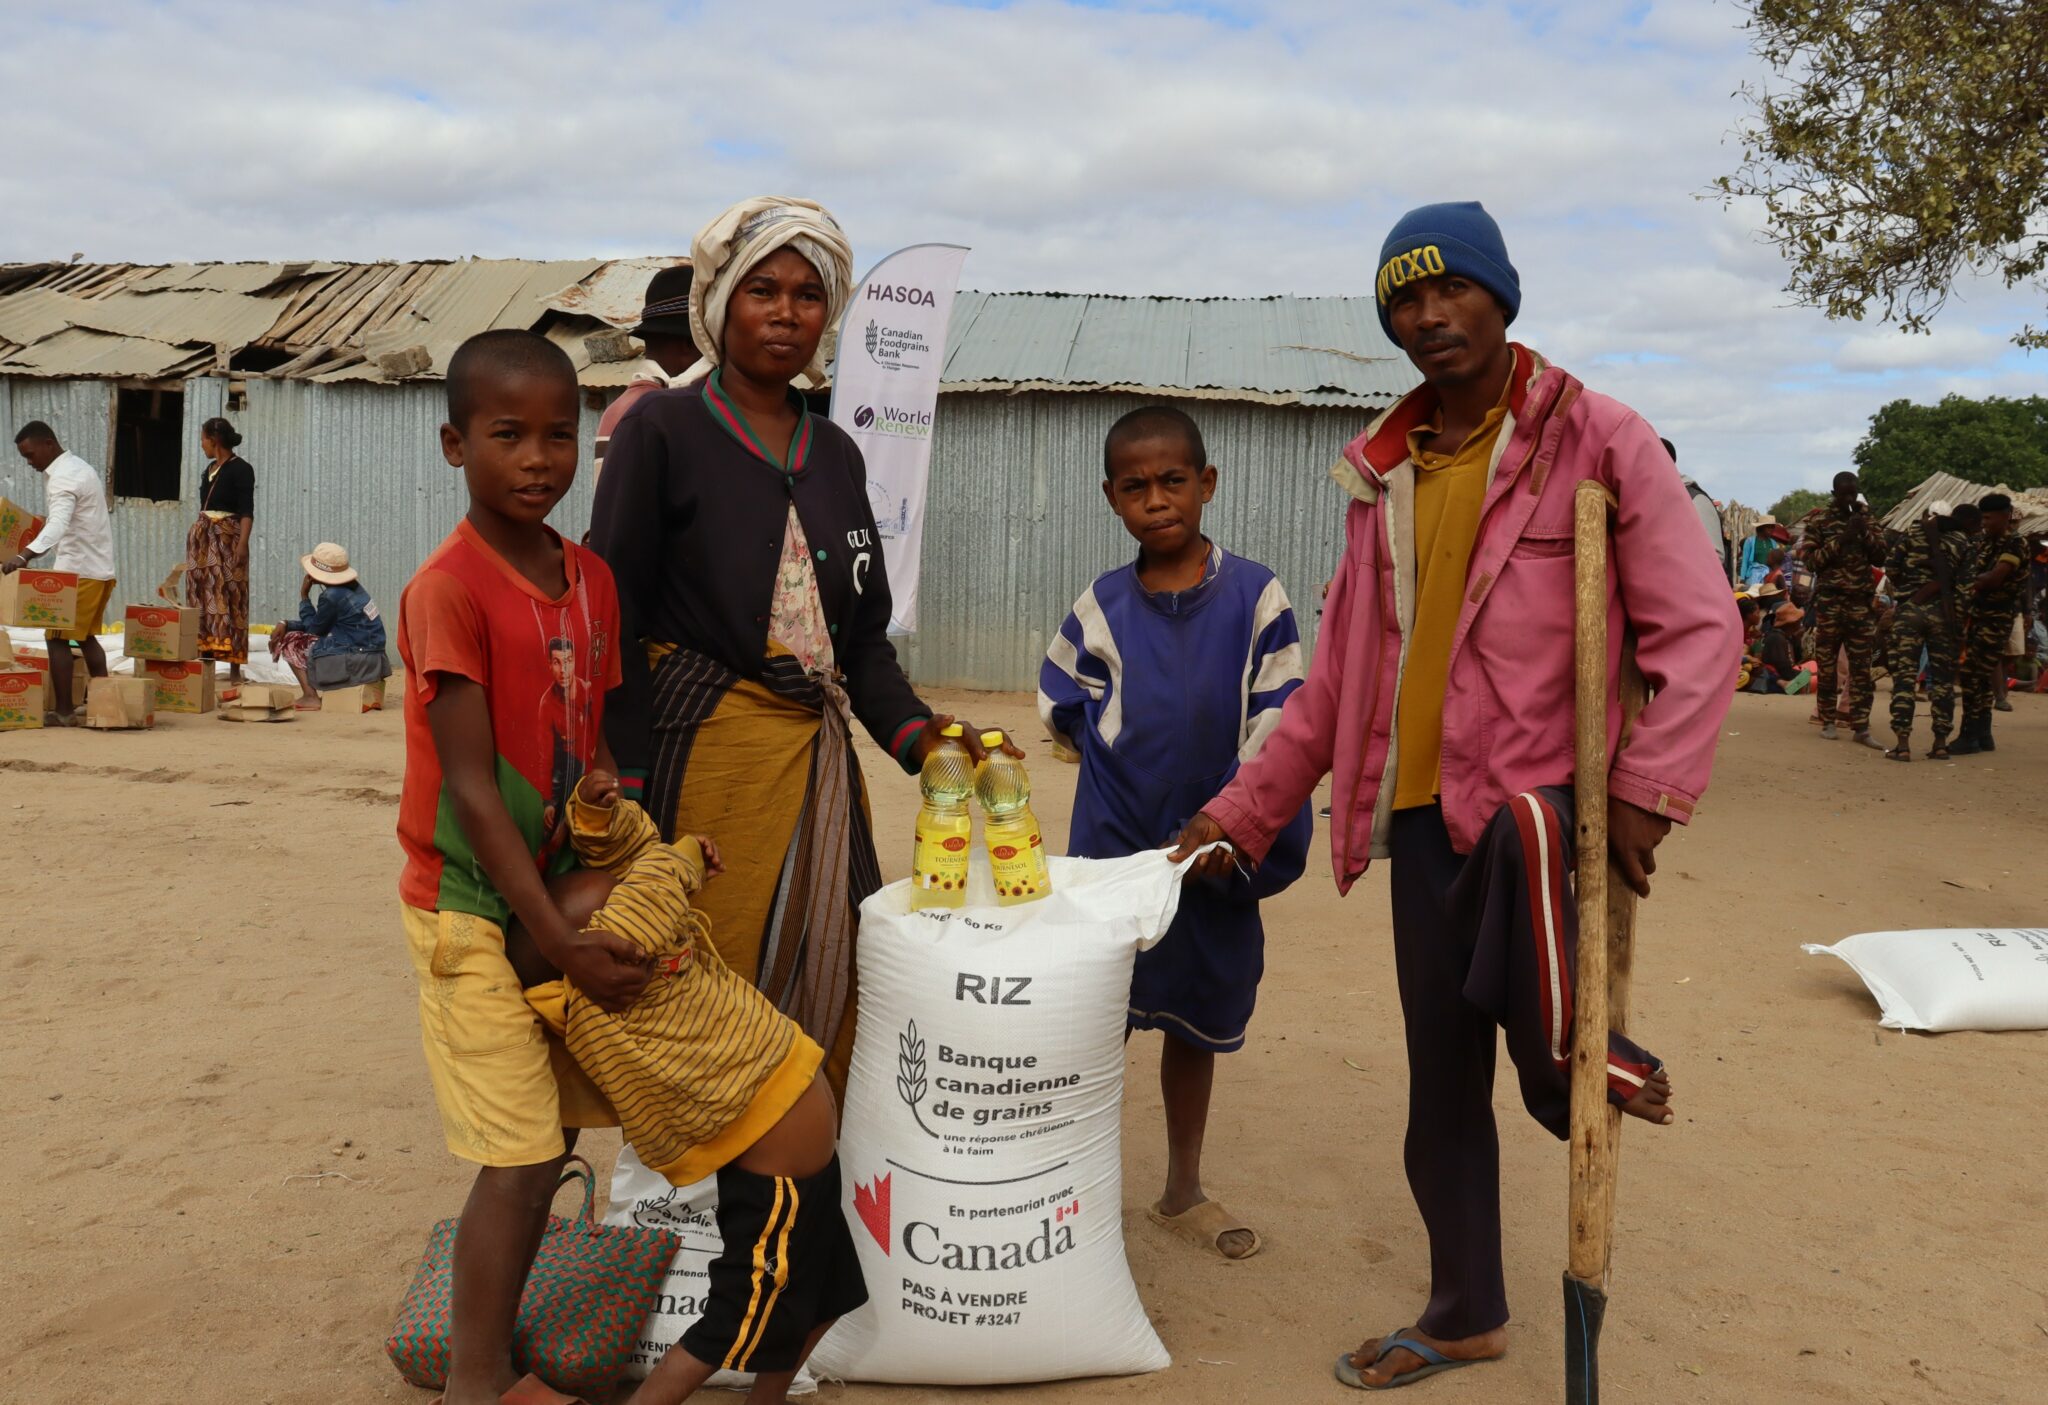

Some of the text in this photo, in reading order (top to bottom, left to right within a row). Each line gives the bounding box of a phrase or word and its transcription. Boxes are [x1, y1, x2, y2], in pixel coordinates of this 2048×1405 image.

[867, 284, 935, 308] HASOA
[879, 339, 929, 353] Foodgrains
[881, 327, 923, 341] Canadian
[878, 348, 901, 359] Bank
[875, 416, 930, 436] Renew
[884, 406, 931, 426] World
[929, 913, 952, 922] NET
[964, 917, 980, 929] 60
[955, 972, 1033, 1006] RIZ
[938, 1044, 1038, 1074] Banque
[935, 1073, 1081, 1096] canadienne
[932, 1100, 1053, 1126] de grains
[943, 1118, 1075, 1145] une réponse chrétienne
[943, 1144, 994, 1156] à la faim
[949, 1185, 1074, 1220] En partenariat avec
[902, 1217, 1077, 1272] Canada
[902, 1277, 1028, 1307] PAS À VENDRE
[902, 1298, 1022, 1327] PROJET #3247
